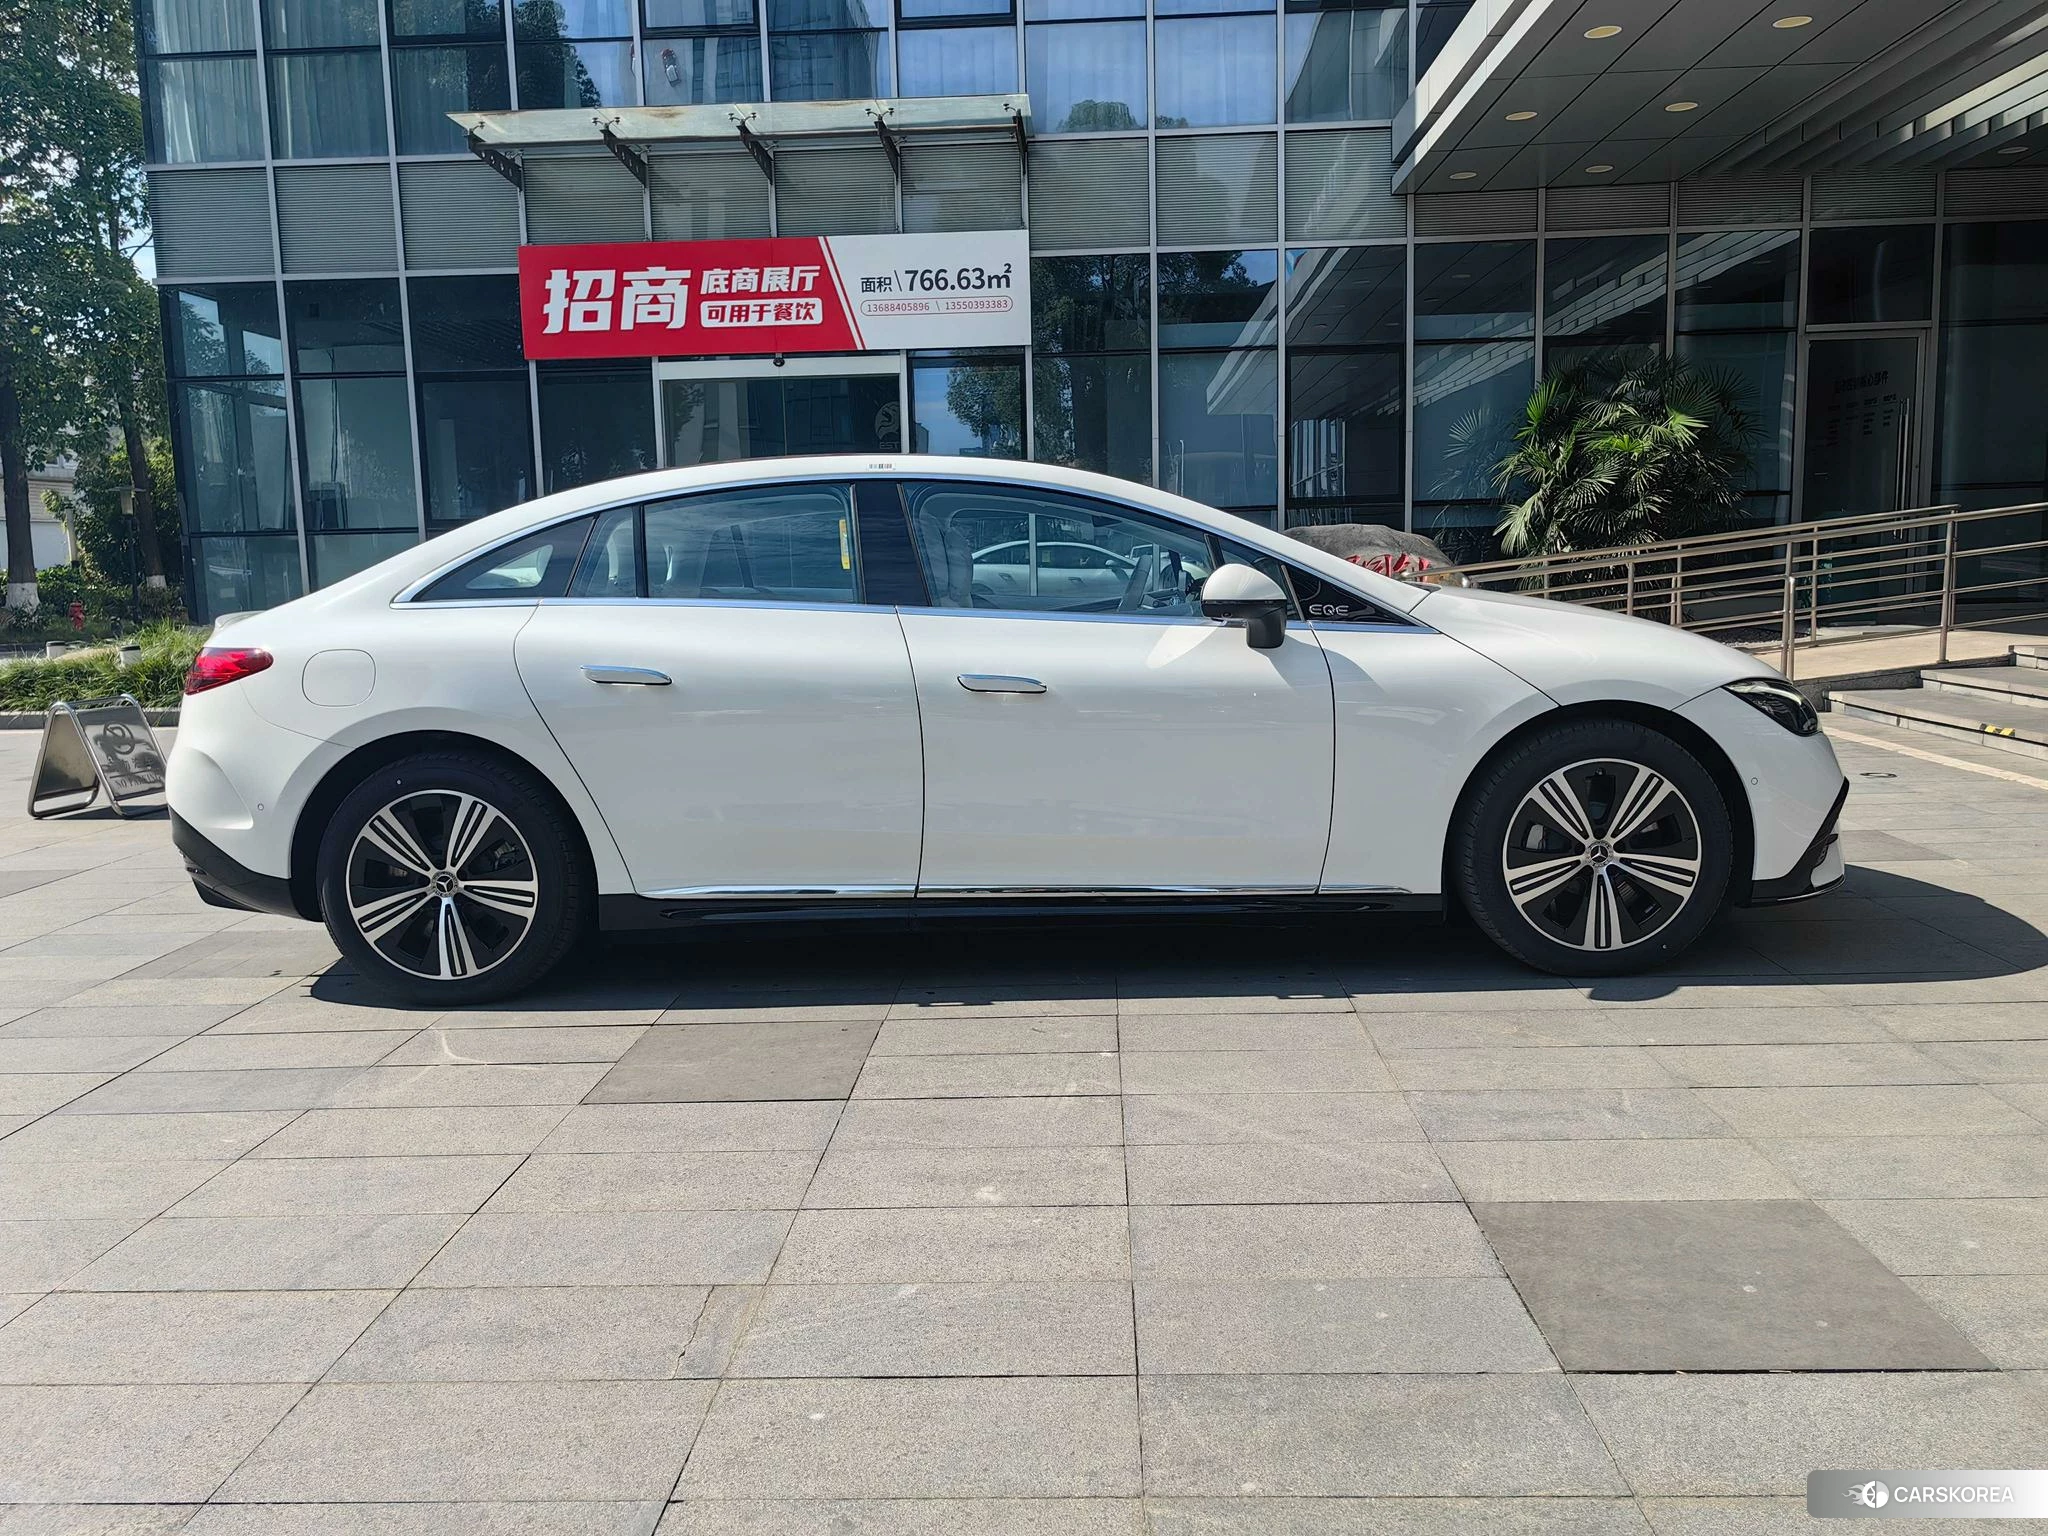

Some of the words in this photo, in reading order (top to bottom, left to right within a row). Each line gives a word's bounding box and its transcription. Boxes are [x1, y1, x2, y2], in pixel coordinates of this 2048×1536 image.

[700, 266, 821, 295] 底商展厅
[542, 266, 692, 334] 招商
[867, 302, 930, 312] 13688405896
[945, 300, 1008, 310] 13550393383
[707, 301, 816, 324] 可用于餐饮
[1309, 604, 1349, 616] EQE
